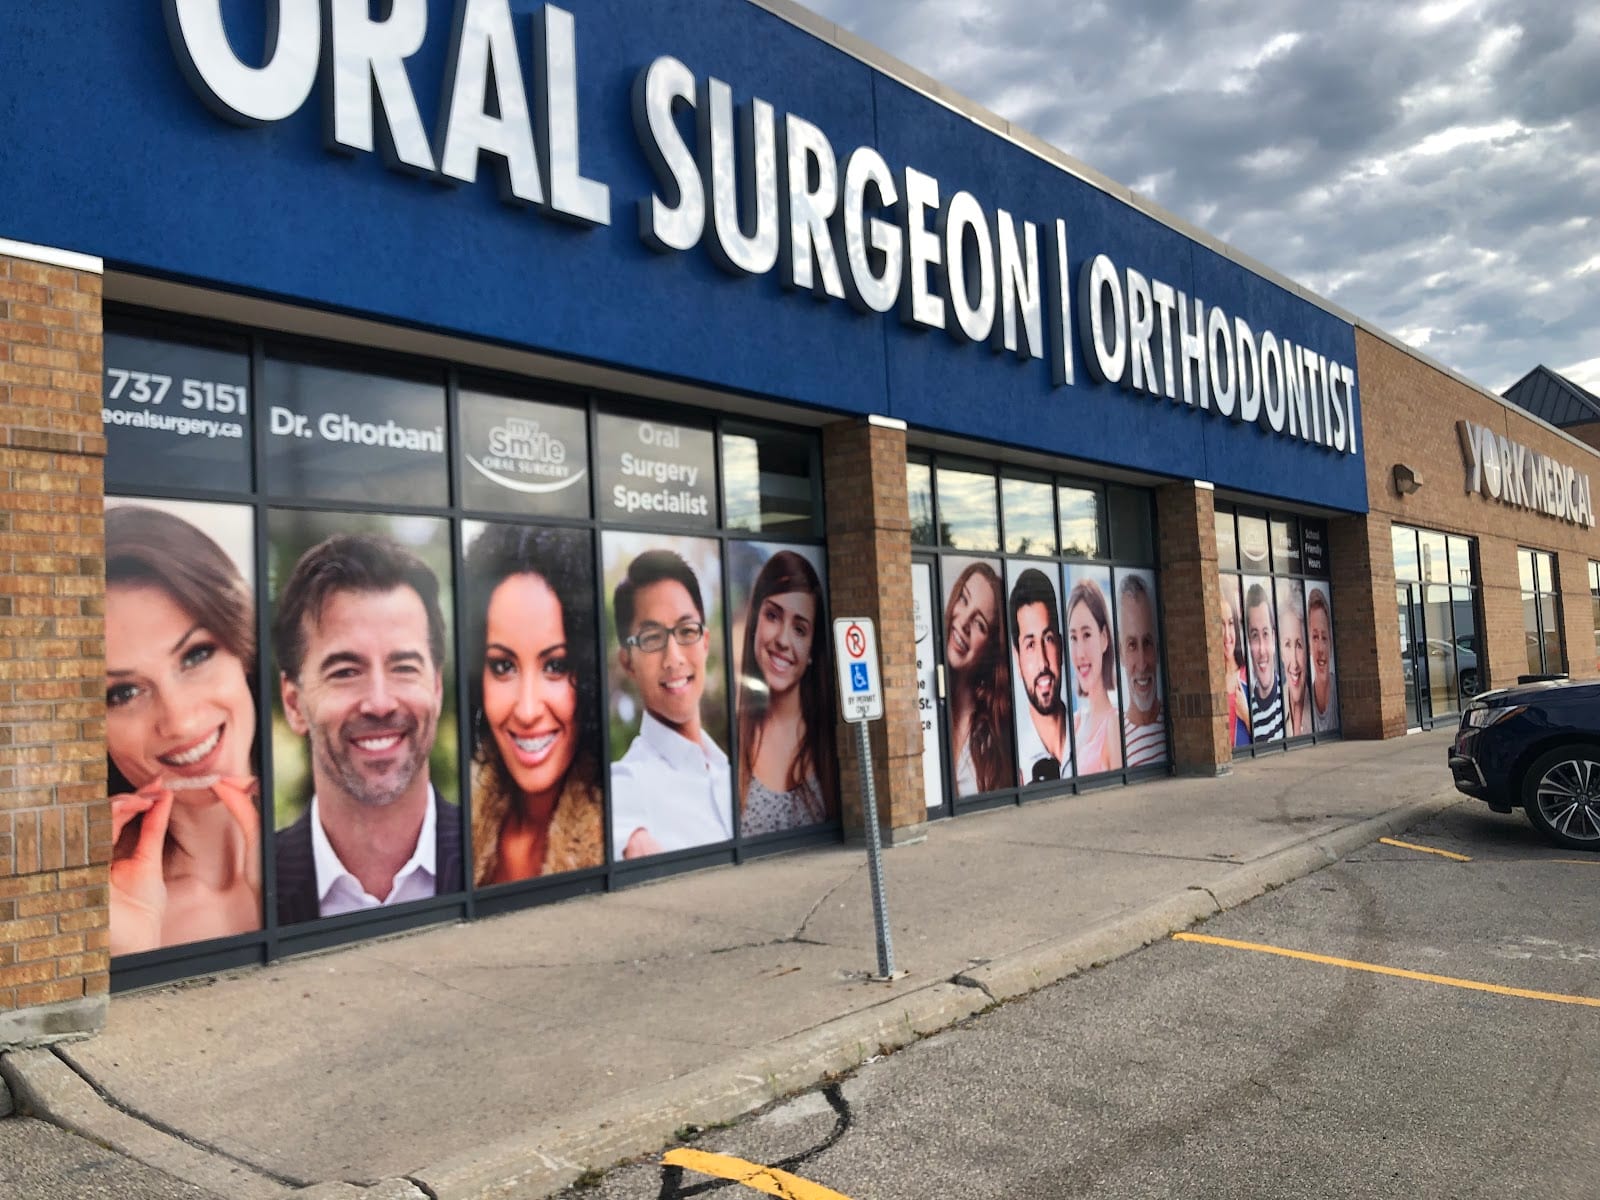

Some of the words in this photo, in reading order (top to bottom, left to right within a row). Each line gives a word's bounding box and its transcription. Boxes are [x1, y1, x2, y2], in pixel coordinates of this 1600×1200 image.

[645, 54, 1044, 360] SURGEON
[1089, 253, 1357, 455] ORTHODONTIST
[106, 367, 173, 405] 737
[181, 378, 248, 416] 5151
[269, 406, 313, 438] Dr.
[319, 412, 444, 453] Ghorbani
[637, 422, 680, 449] Oral
[620, 453, 699, 488] Surgery
[1463, 418, 1530, 508] YORK
[1530, 448, 1596, 528] MEDICAL
[613, 485, 709, 517] Specialist
